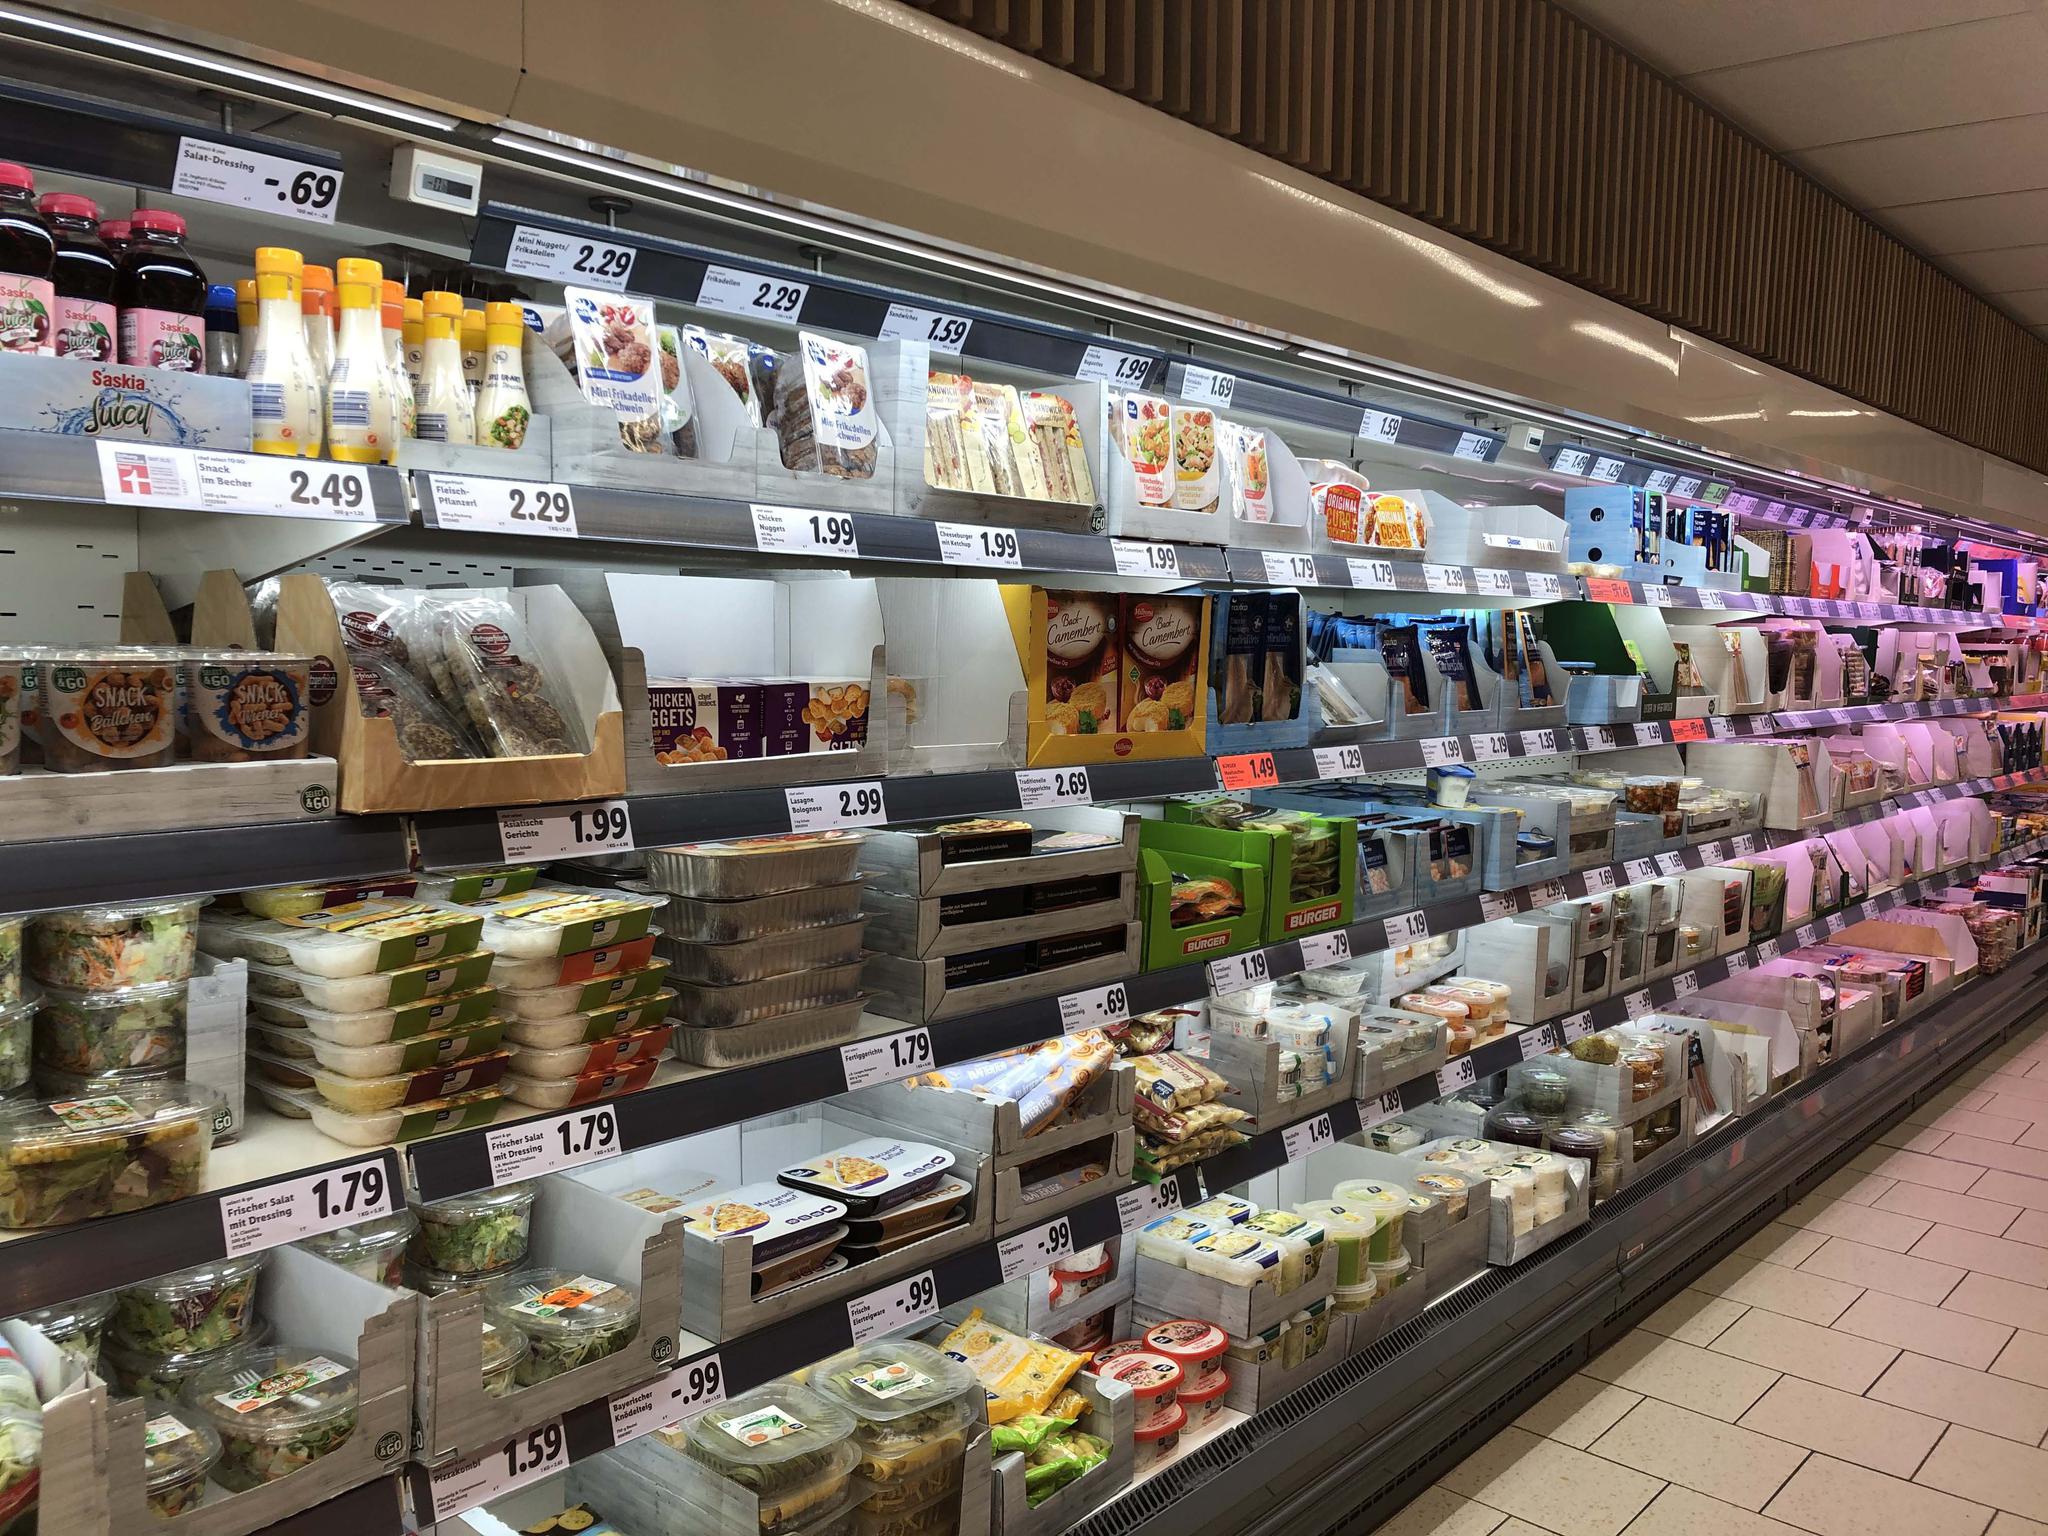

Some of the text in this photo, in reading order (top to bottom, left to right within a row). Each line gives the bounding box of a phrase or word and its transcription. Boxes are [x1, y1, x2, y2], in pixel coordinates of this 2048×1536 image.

[183, 149, 255, 173] Salat-Dressing
[264, 171, 337, 209] -.69
[514, 245, 556, 258] Frikadellen
[517, 235, 570, 252] Mini Nuggets/
[573, 244, 631, 278] 2.29
[706, 275, 741, 287] Frikadellen
[0, 286, 34, 299] Saskia
[752, 283, 801, 312] 2.29
[65, 309, 97, 322] Saskia
[888, 310, 918, 321] Sandwiches
[160, 321, 190, 333] Saskia
[927, 317, 967, 343] 1.59
[1115, 356, 1149, 381] 1.99
[92, 370, 145, 391] Saskia
[1211, 375, 1234, 398] 1.69
[591, 386, 611, 399] Mini
[84, 392, 151, 435] Juicy
[1380, 416, 1399, 437] 1.59
[1472, 438, 1490, 455] 1.99
[199, 463, 230, 474] Snack
[201, 475, 253, 488] im Becher
[289, 470, 363, 508] 2.49
[436, 485, 470, 497] Fleisch-
[508, 488, 570, 523] 2.29
[1327, 493, 1358, 513] ORIGINAL
[757, 514, 783, 523] Chicken
[759, 523, 786, 533] Nuggets
[809, 516, 855, 546] 1.99
[939, 530, 973, 540] Cheeseburger
[951, 539, 972, 549] Ketchup
[980, 532, 1017, 559] 1.99
[1146, 546, 1176, 570] 1.99
[1289, 557, 1315, 579] 1.79
[1371, 563, 1393, 583] 1.79
[1444, 568, 1463, 587] 2.39
[1493, 573, 1510, 590] 2.99
[1046, 615, 1102, 646] Camembert
[1142, 618, 1191, 648] Camembert
[58, 678, 87, 689] &GO
[203, 675, 230, 687] &GO
[95, 687, 148, 708] SNACK
[237, 684, 282, 703] SNACK
[698, 693, 712, 702] chef
[698, 699, 717, 707] select
[90, 709, 154, 732] Bällchen
[651, 707, 694, 727] GGETS
[1538, 731, 1554, 750] 1.35
[1599, 727, 1614, 744] 1.79
[1647, 725, 1661, 740] 1.99
[1441, 740, 1460, 759] 1.99
[1490, 736, 1508, 754] 2.19
[1249, 756, 1274, 779] 1.49
[1338, 749, 1362, 770] 1.29
[305, 789, 324, 798] SELECT
[1020, 784, 1051, 793] Fertiggerichte
[1055, 771, 1088, 796] 2.69
[306, 796, 330, 810] &GO
[790, 796, 814, 806] Lasagne
[791, 804, 823, 815] Bolognese
[839, 788, 881, 817] 2.99
[503, 818, 544, 830] Asiatische
[569, 807, 628, 844] 1.99
[505, 829, 540, 840] Gerichte
[1638, 860, 1653, 876] 1.79
[1544, 881, 1561, 898] 2.99
[1289, 906, 1338, 929] BÜRGER
[1406, 913, 1425, 936] 1.19
[1187, 935, 1227, 952] BÜRGER
[1326, 932, 1348, 956] -.79
[1240, 953, 1266, 980] 1.19
[1061, 1001, 1078, 1010] Frischer
[1096, 987, 1125, 1016] -.69
[1537, 1027, 1551, 1047] -.99
[845, 1048, 883, 1063] Fertiggerichte
[889, 1032, 930, 1068] 1.79
[1456, 1060, 1473, 1081] -.99
[1379, 1089, 1399, 1114] 1.89
[215, 1116, 231, 1130] GO
[1308, 1117, 1330, 1143] 1.49
[491, 1131, 544, 1151] Frischer Salat
[556, 1111, 615, 1156] 1.79
[493, 1143, 543, 1162] mit Dressing
[311, 1166, 384, 1219] 1.79
[1151, 1180, 1177, 1209] -.99
[227, 1194, 295, 1219] Frischer Salat
[229, 1206, 293, 1231] mit Dressing
[1037, 1221, 1069, 1255] -.99
[1000, 1243, 1024, 1257] Teigwaren
[895, 1276, 934, 1314] -.99
[850, 1304, 871, 1317] Frische
[852, 1308, 886, 1326] Eierteigware
[655, 1344, 672, 1358] &GO
[671, 1361, 720, 1405] -.99
[612, 1391, 654, 1412] Bayerischer
[614, 1402, 653, 1422] Knödelteig
[380, 1439, 401, 1456] &GO
[502, 1422, 563, 1477] 1.59
[433, 1459, 482, 1484] Pizzakombi
